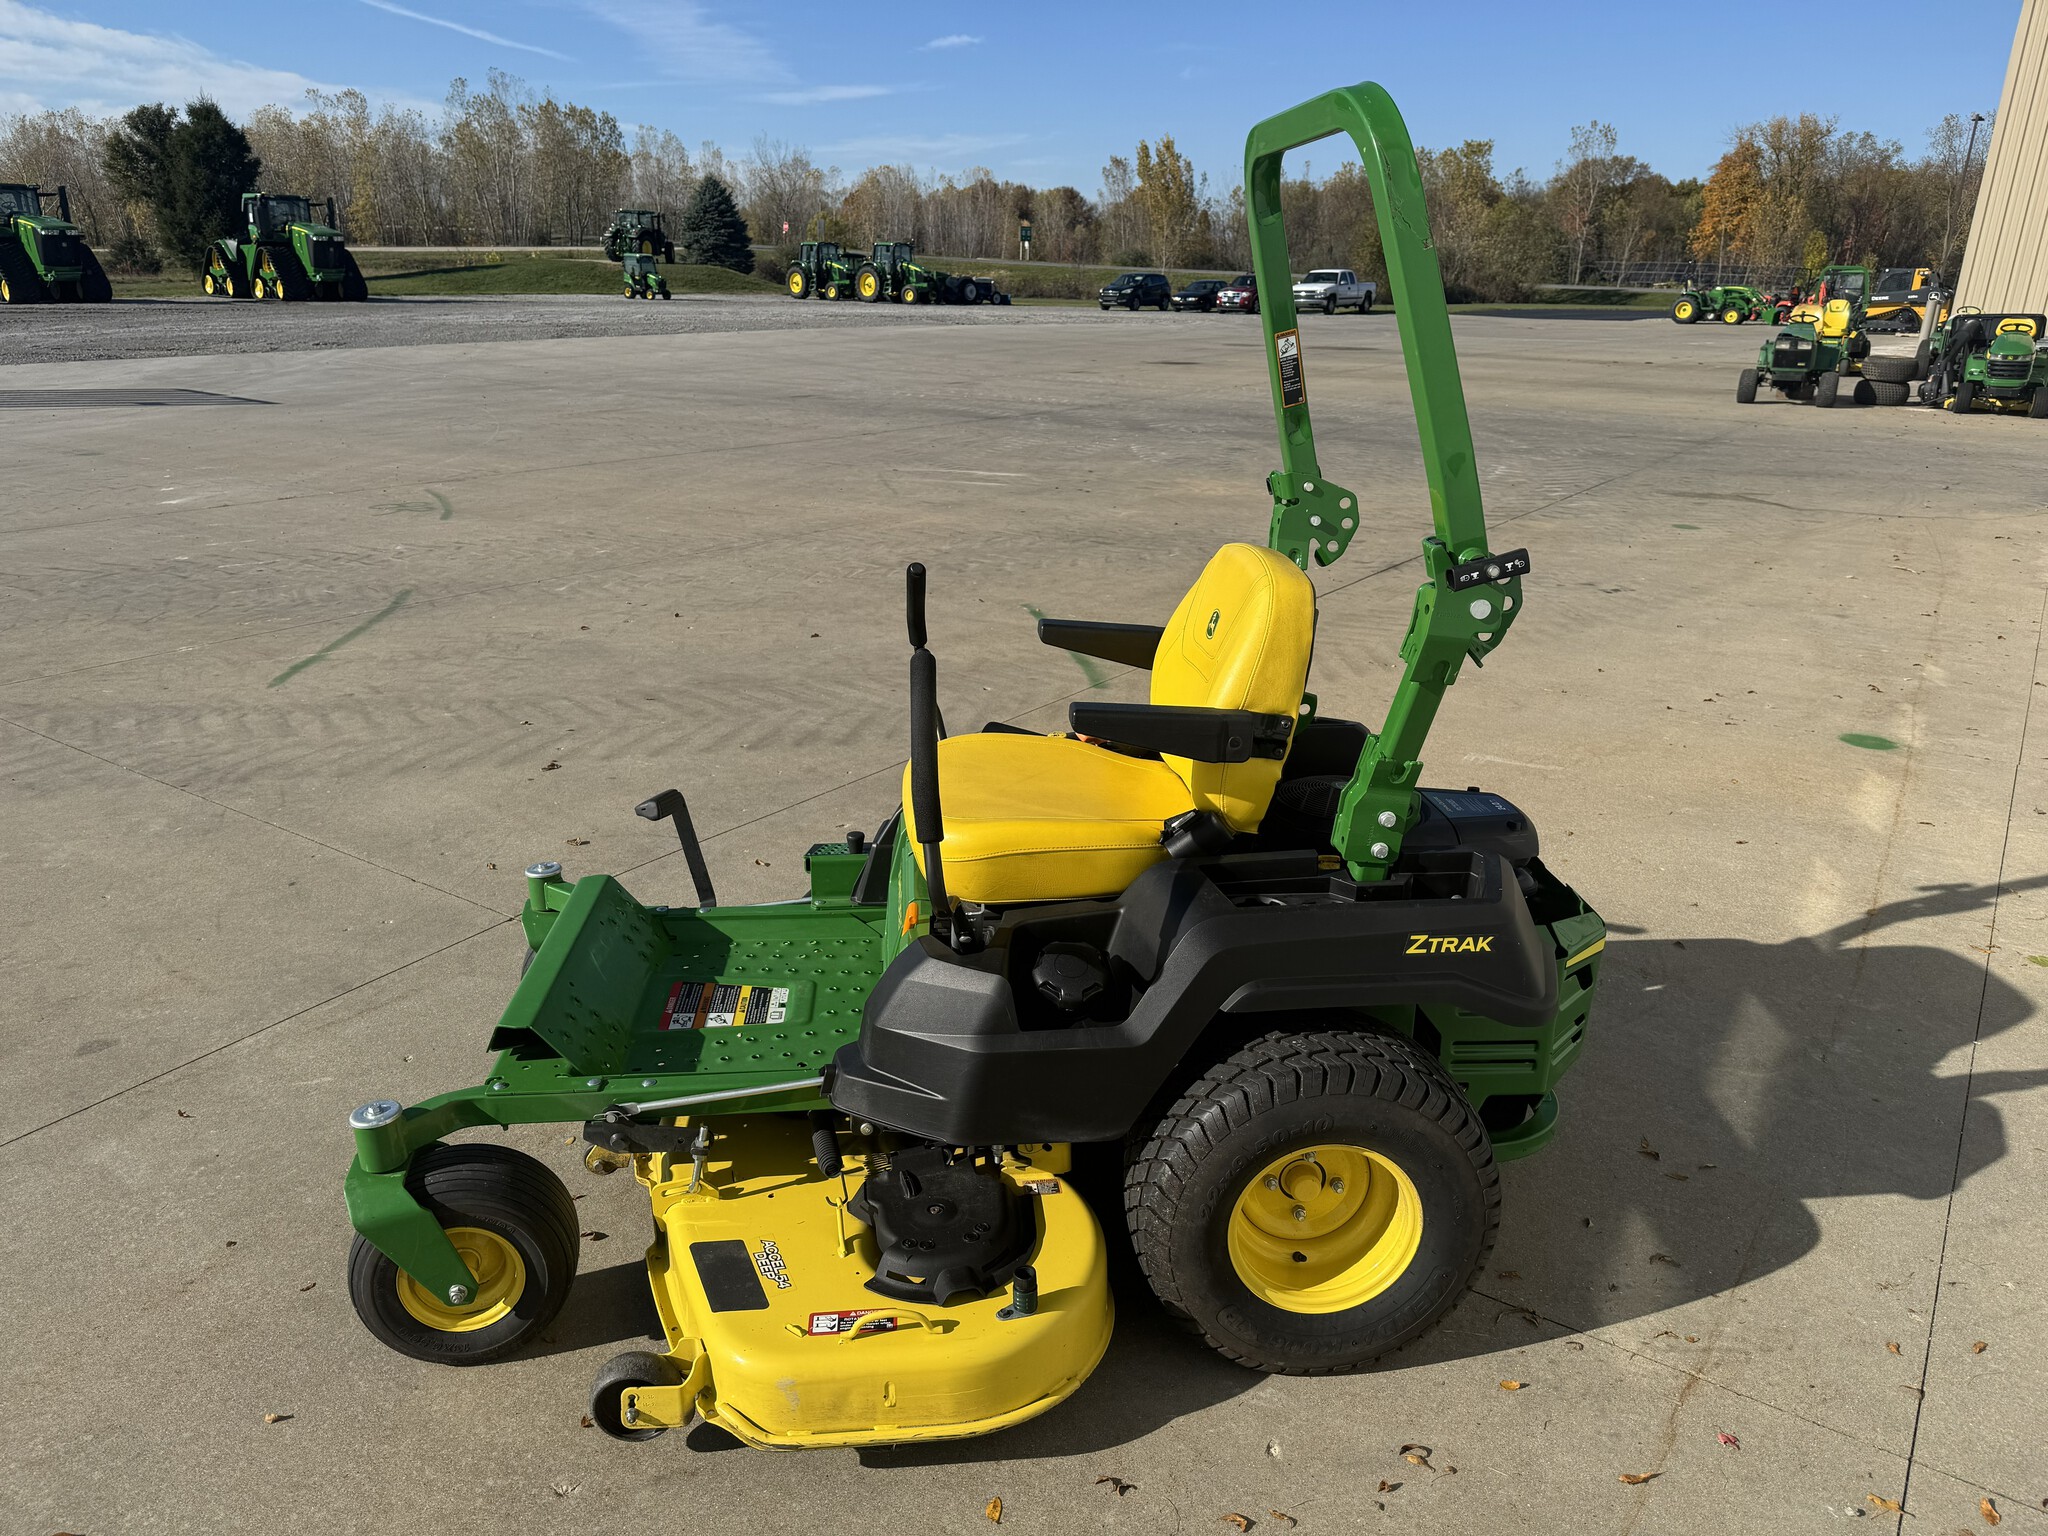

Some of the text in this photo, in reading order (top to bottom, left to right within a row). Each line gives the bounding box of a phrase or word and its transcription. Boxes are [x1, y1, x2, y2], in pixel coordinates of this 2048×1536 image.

[1405, 934, 1495, 954] ZTRAK
[753, 1251, 776, 1280] DEEP
[760, 1240, 792, 1289] ACCEL 54
